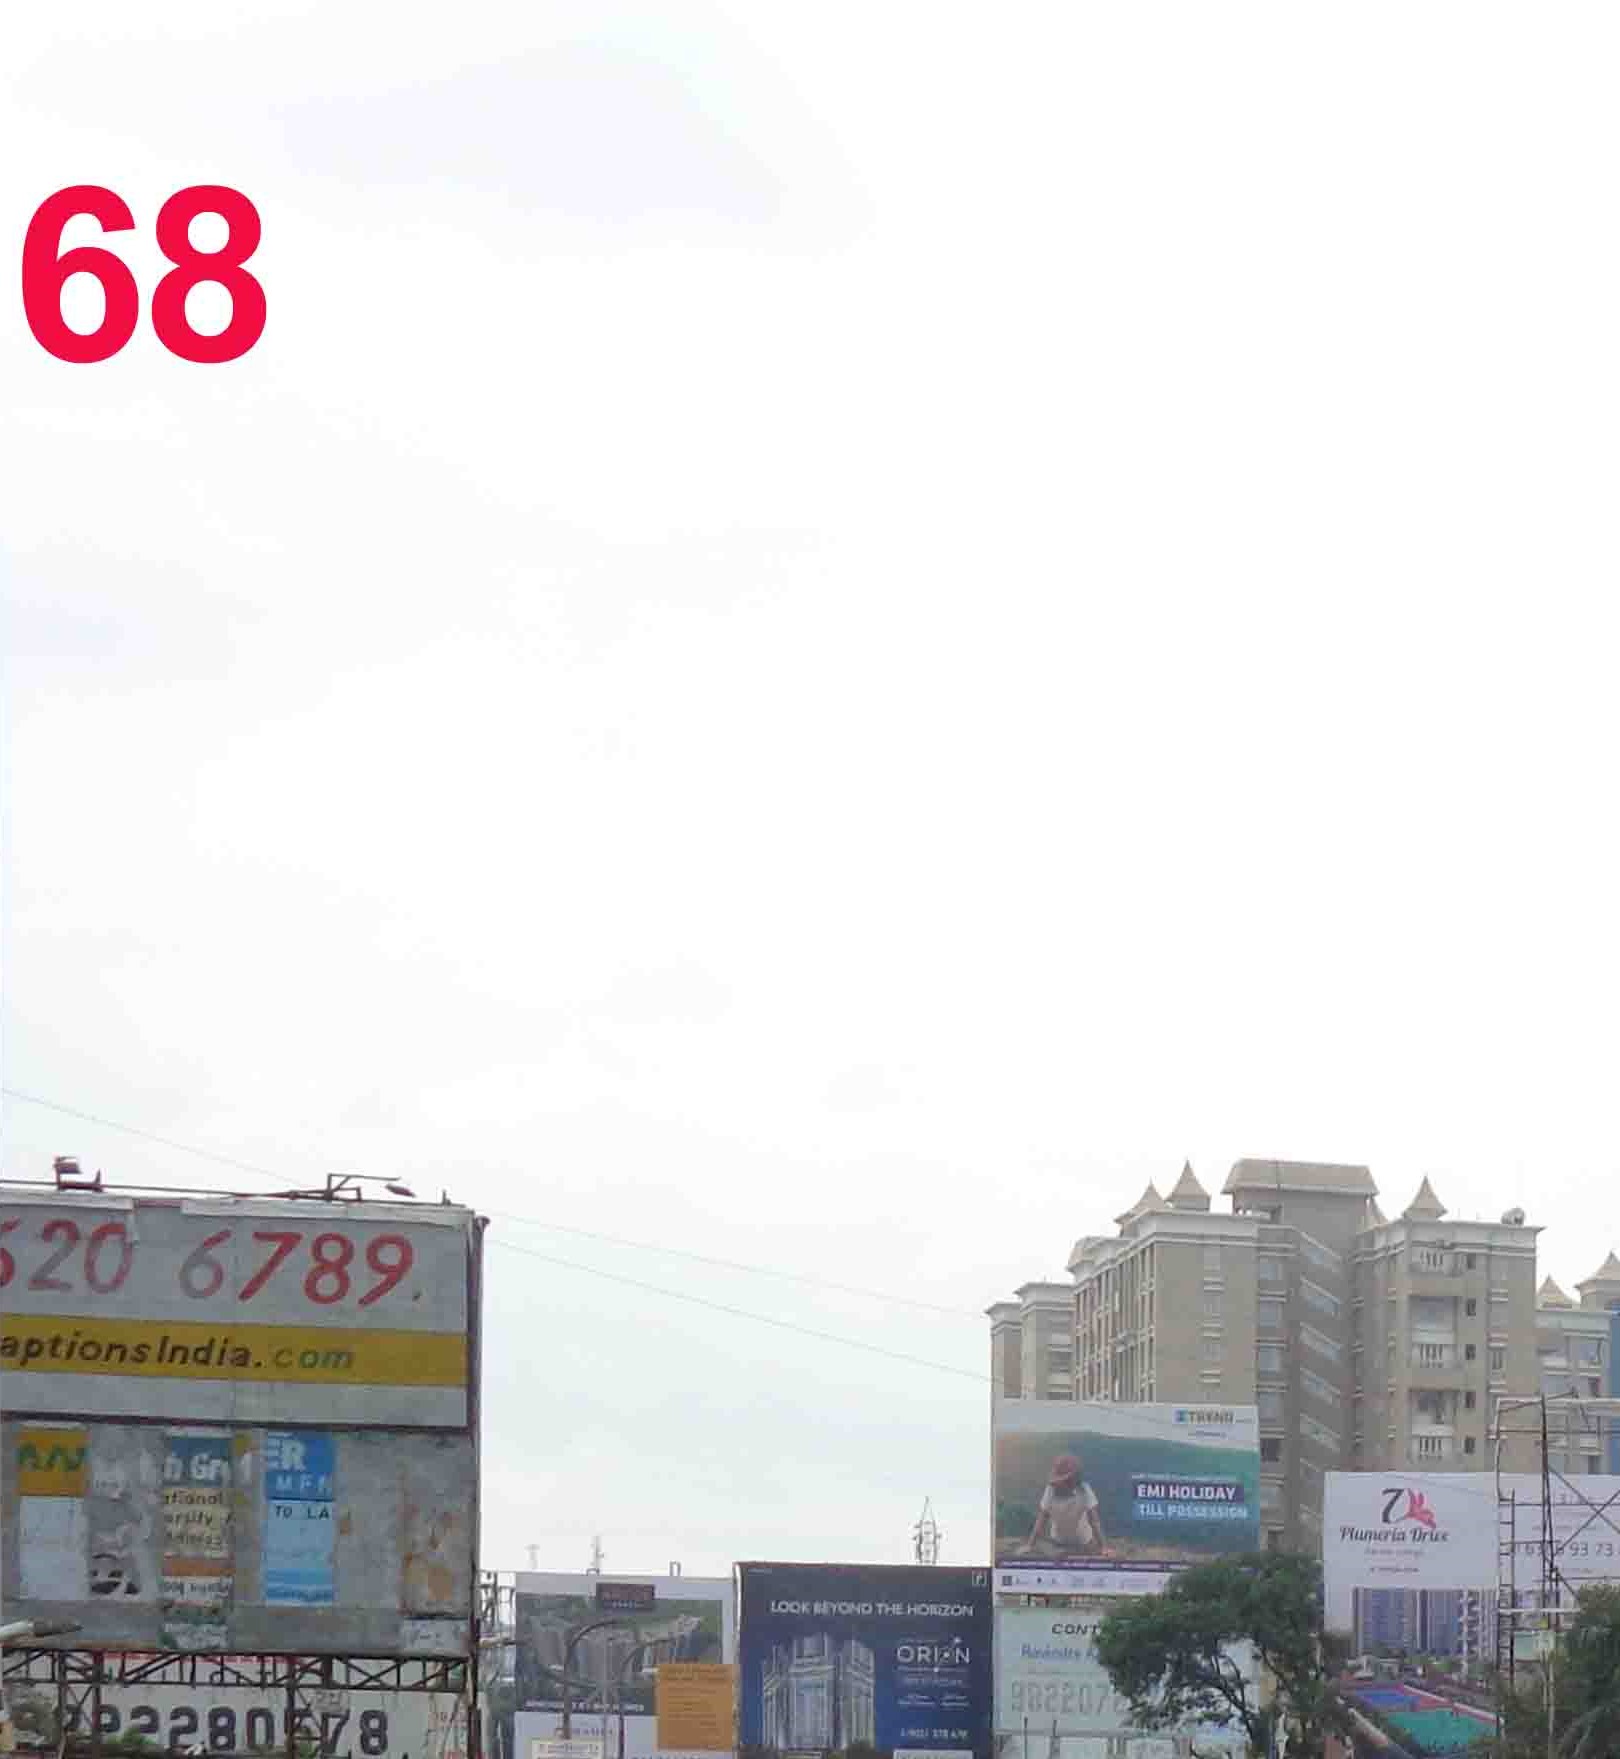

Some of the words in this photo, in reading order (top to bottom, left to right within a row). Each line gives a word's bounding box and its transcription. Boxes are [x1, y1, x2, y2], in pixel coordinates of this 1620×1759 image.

[179, 1230, 414, 1307] 6789
[1137, 1484, 1165, 1497] EMI
[1169, 1485, 1236, 1500] HOLIDAY
